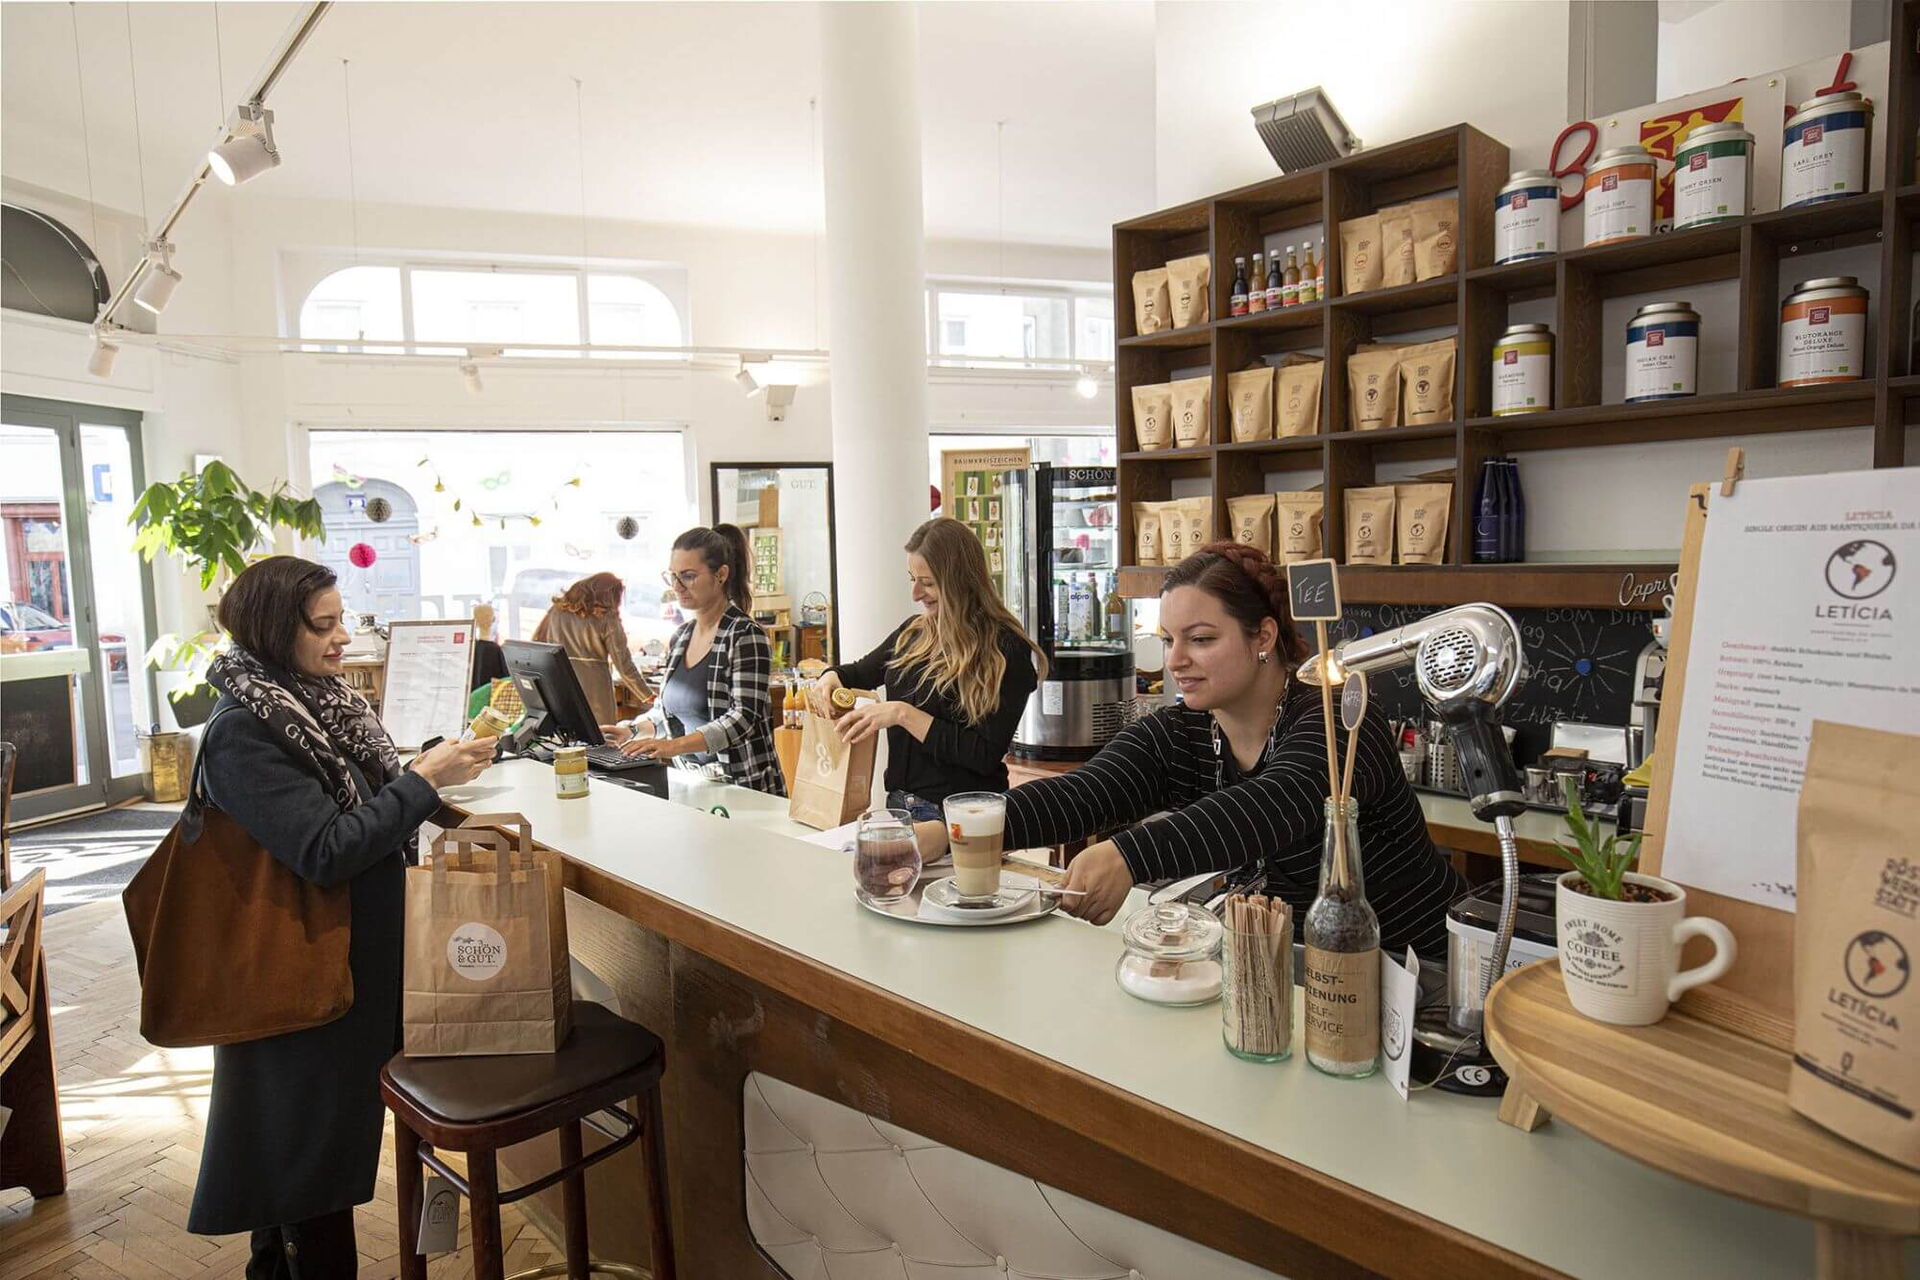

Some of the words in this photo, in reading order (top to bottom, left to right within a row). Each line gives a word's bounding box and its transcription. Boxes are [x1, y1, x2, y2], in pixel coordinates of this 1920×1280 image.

[1070, 592, 1090, 601] alpro
[1296, 576, 1329, 604] TEE
[1815, 603, 1894, 621] LETÍCIA
[457, 943, 501, 955] SCHÖN
[1567, 939, 1621, 962] COFFEE
